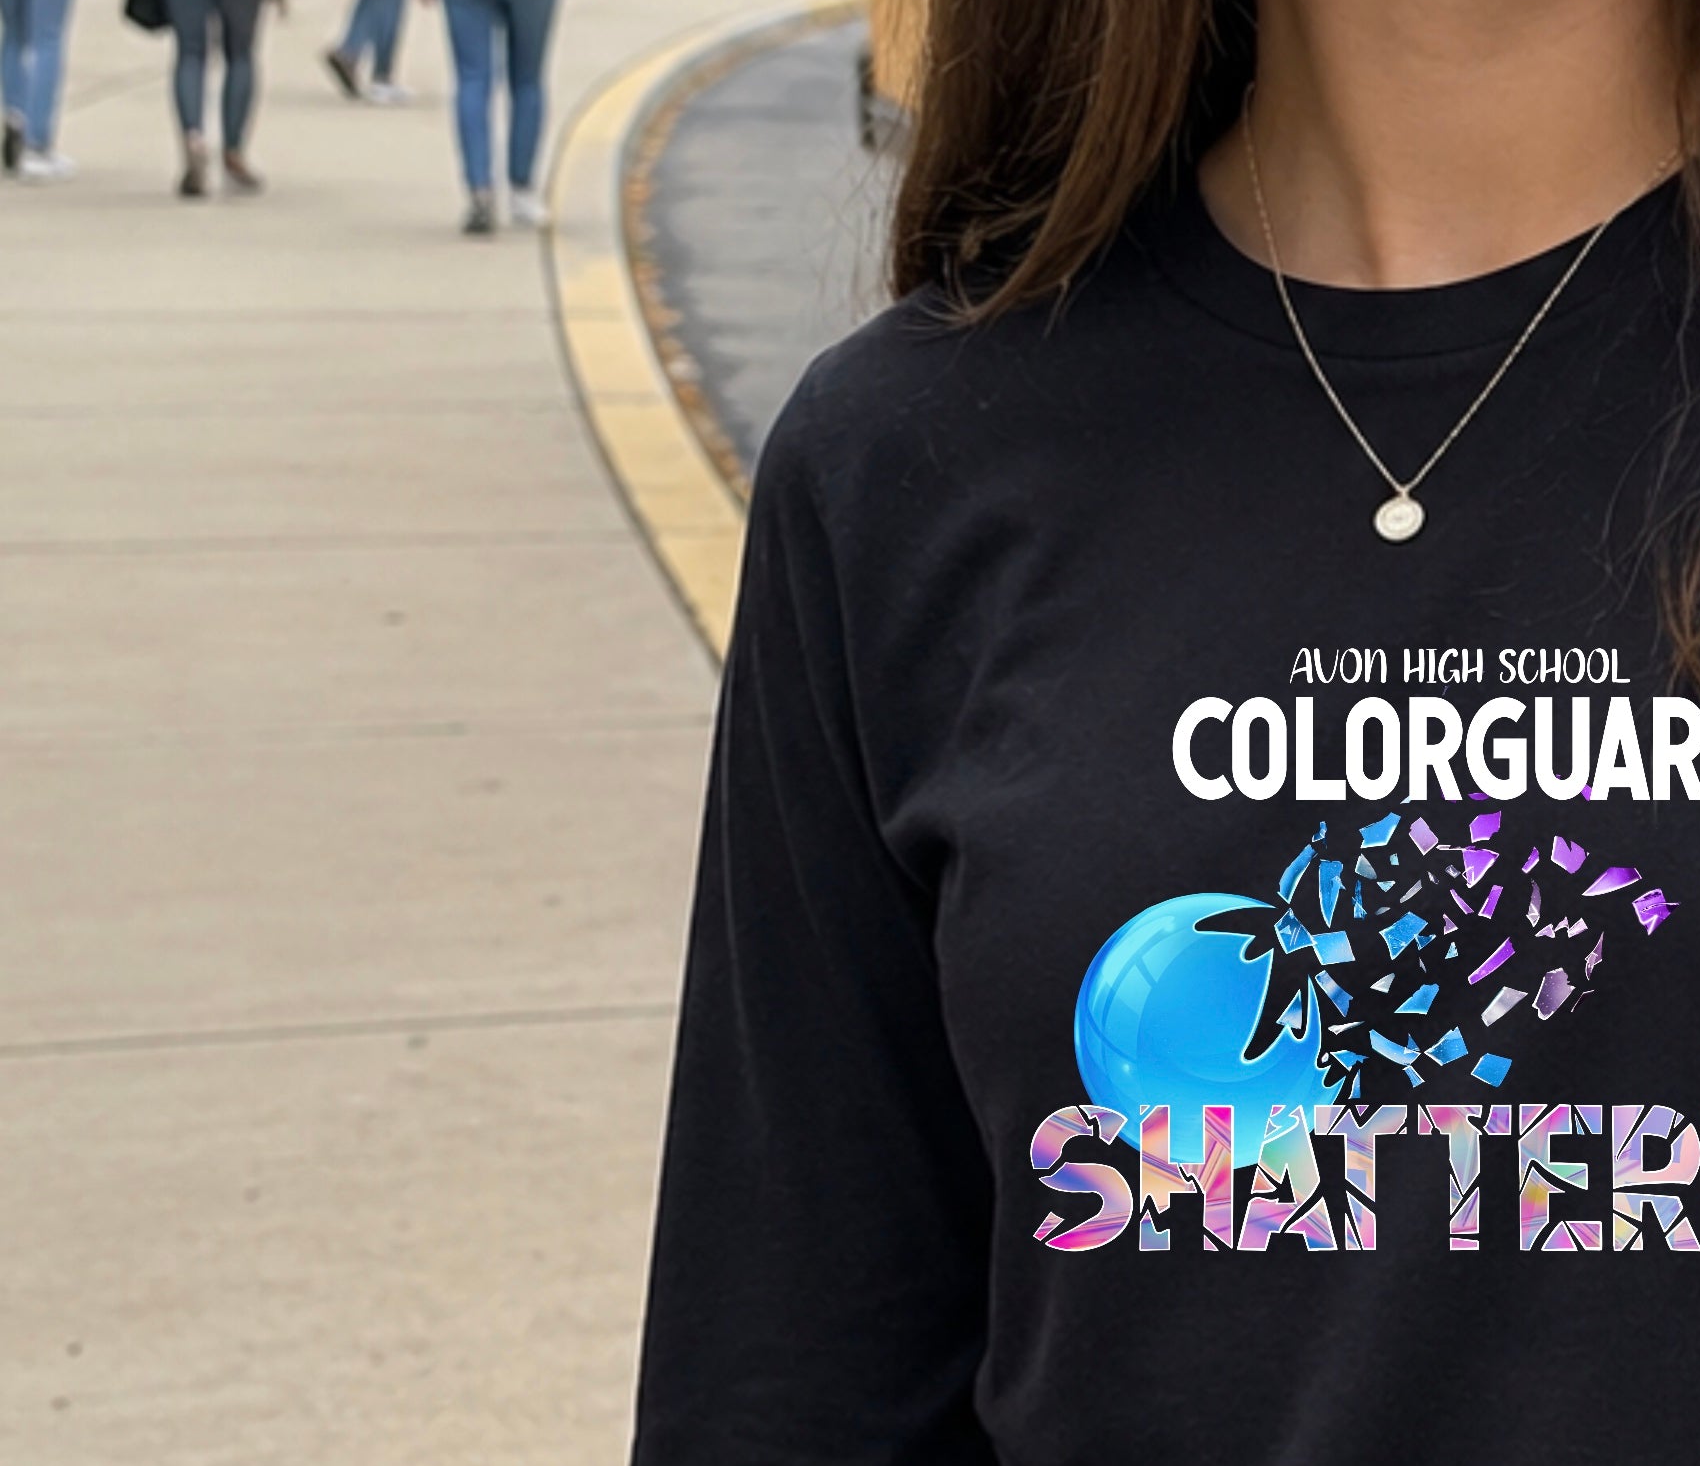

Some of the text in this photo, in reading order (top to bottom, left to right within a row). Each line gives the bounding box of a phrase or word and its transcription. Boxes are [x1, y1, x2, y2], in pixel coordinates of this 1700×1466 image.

[1289, 647, 1631, 685] AVON HIGH SCHOOL
